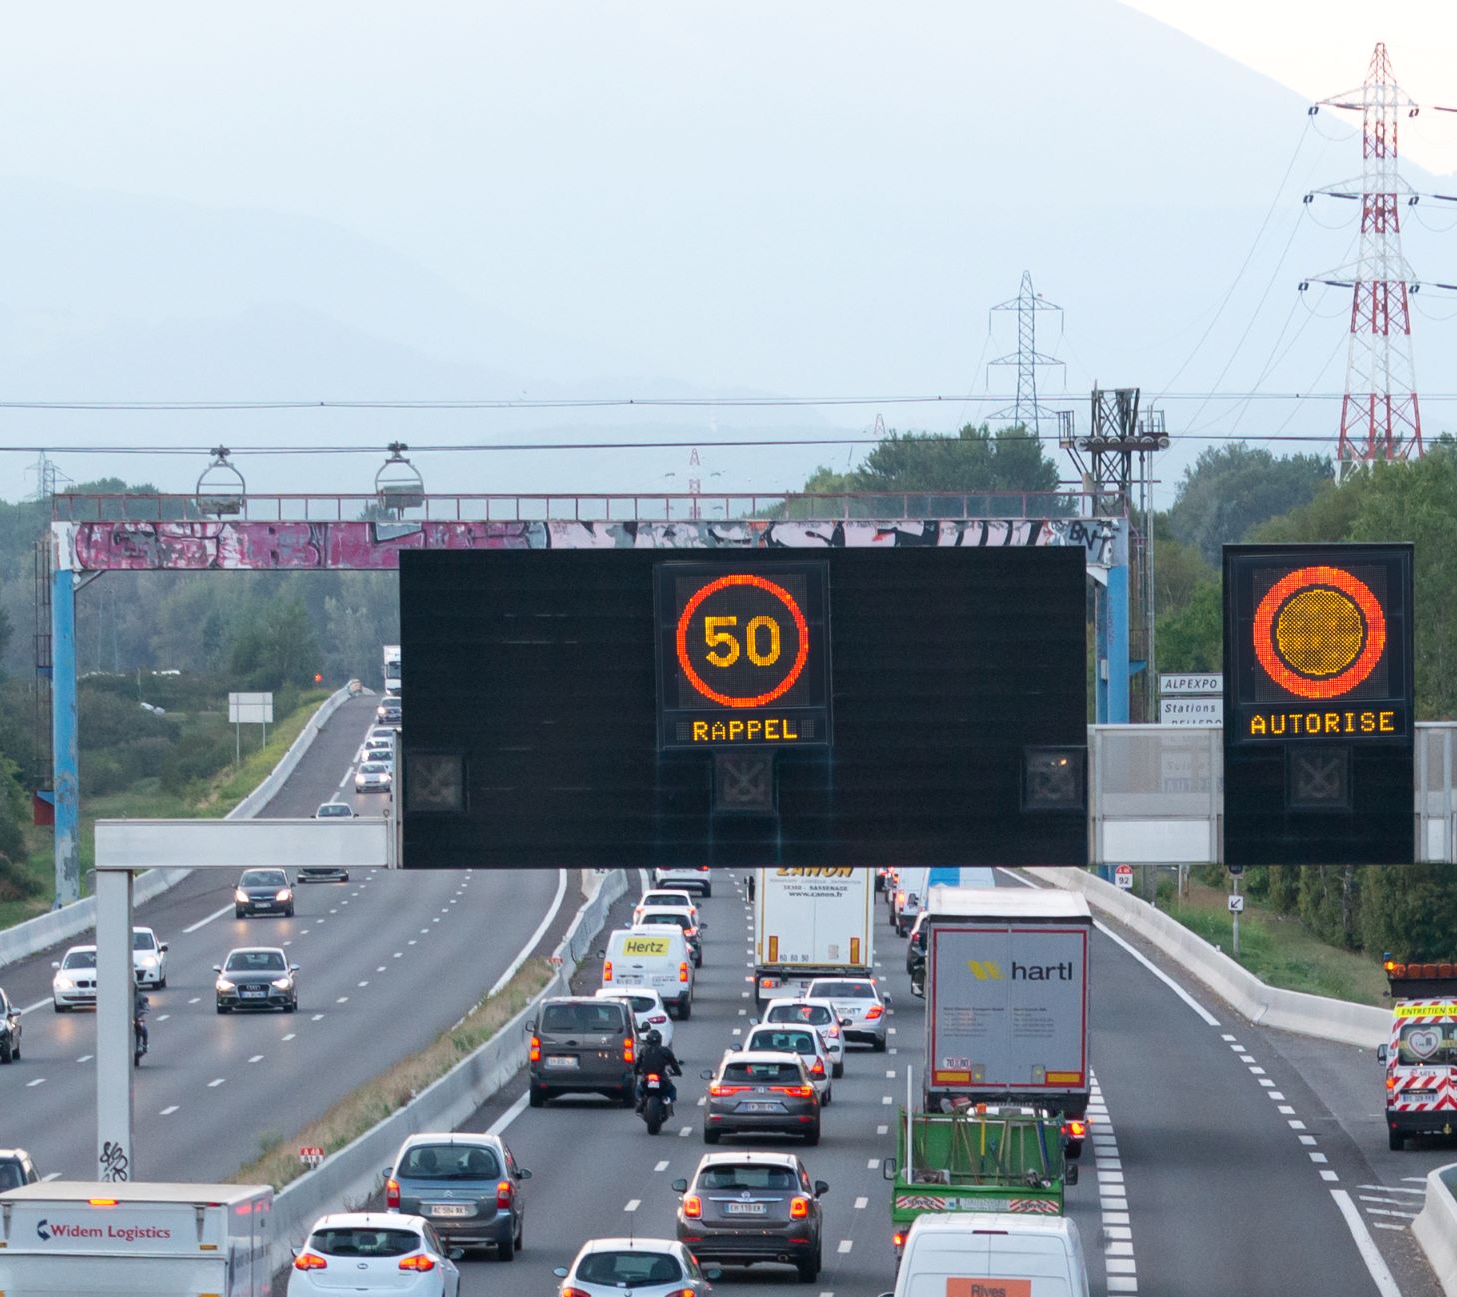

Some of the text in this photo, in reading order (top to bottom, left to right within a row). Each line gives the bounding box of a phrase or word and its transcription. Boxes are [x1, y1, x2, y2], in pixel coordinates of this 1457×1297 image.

[704, 615, 781, 667] 50
[1165, 679, 1218, 689] ALPEXPO
[1165, 704, 1216, 713] Stations
[693, 720, 797, 740] RAPPEL
[1251, 711, 1395, 734] AUTORISE
[627, 942, 664, 953] Hertz
[1011, 961, 1073, 980] hartl
[1401, 1007, 1445, 1015] ENTRETIEN
[50, 1224, 171, 1242] Widem Logistics
